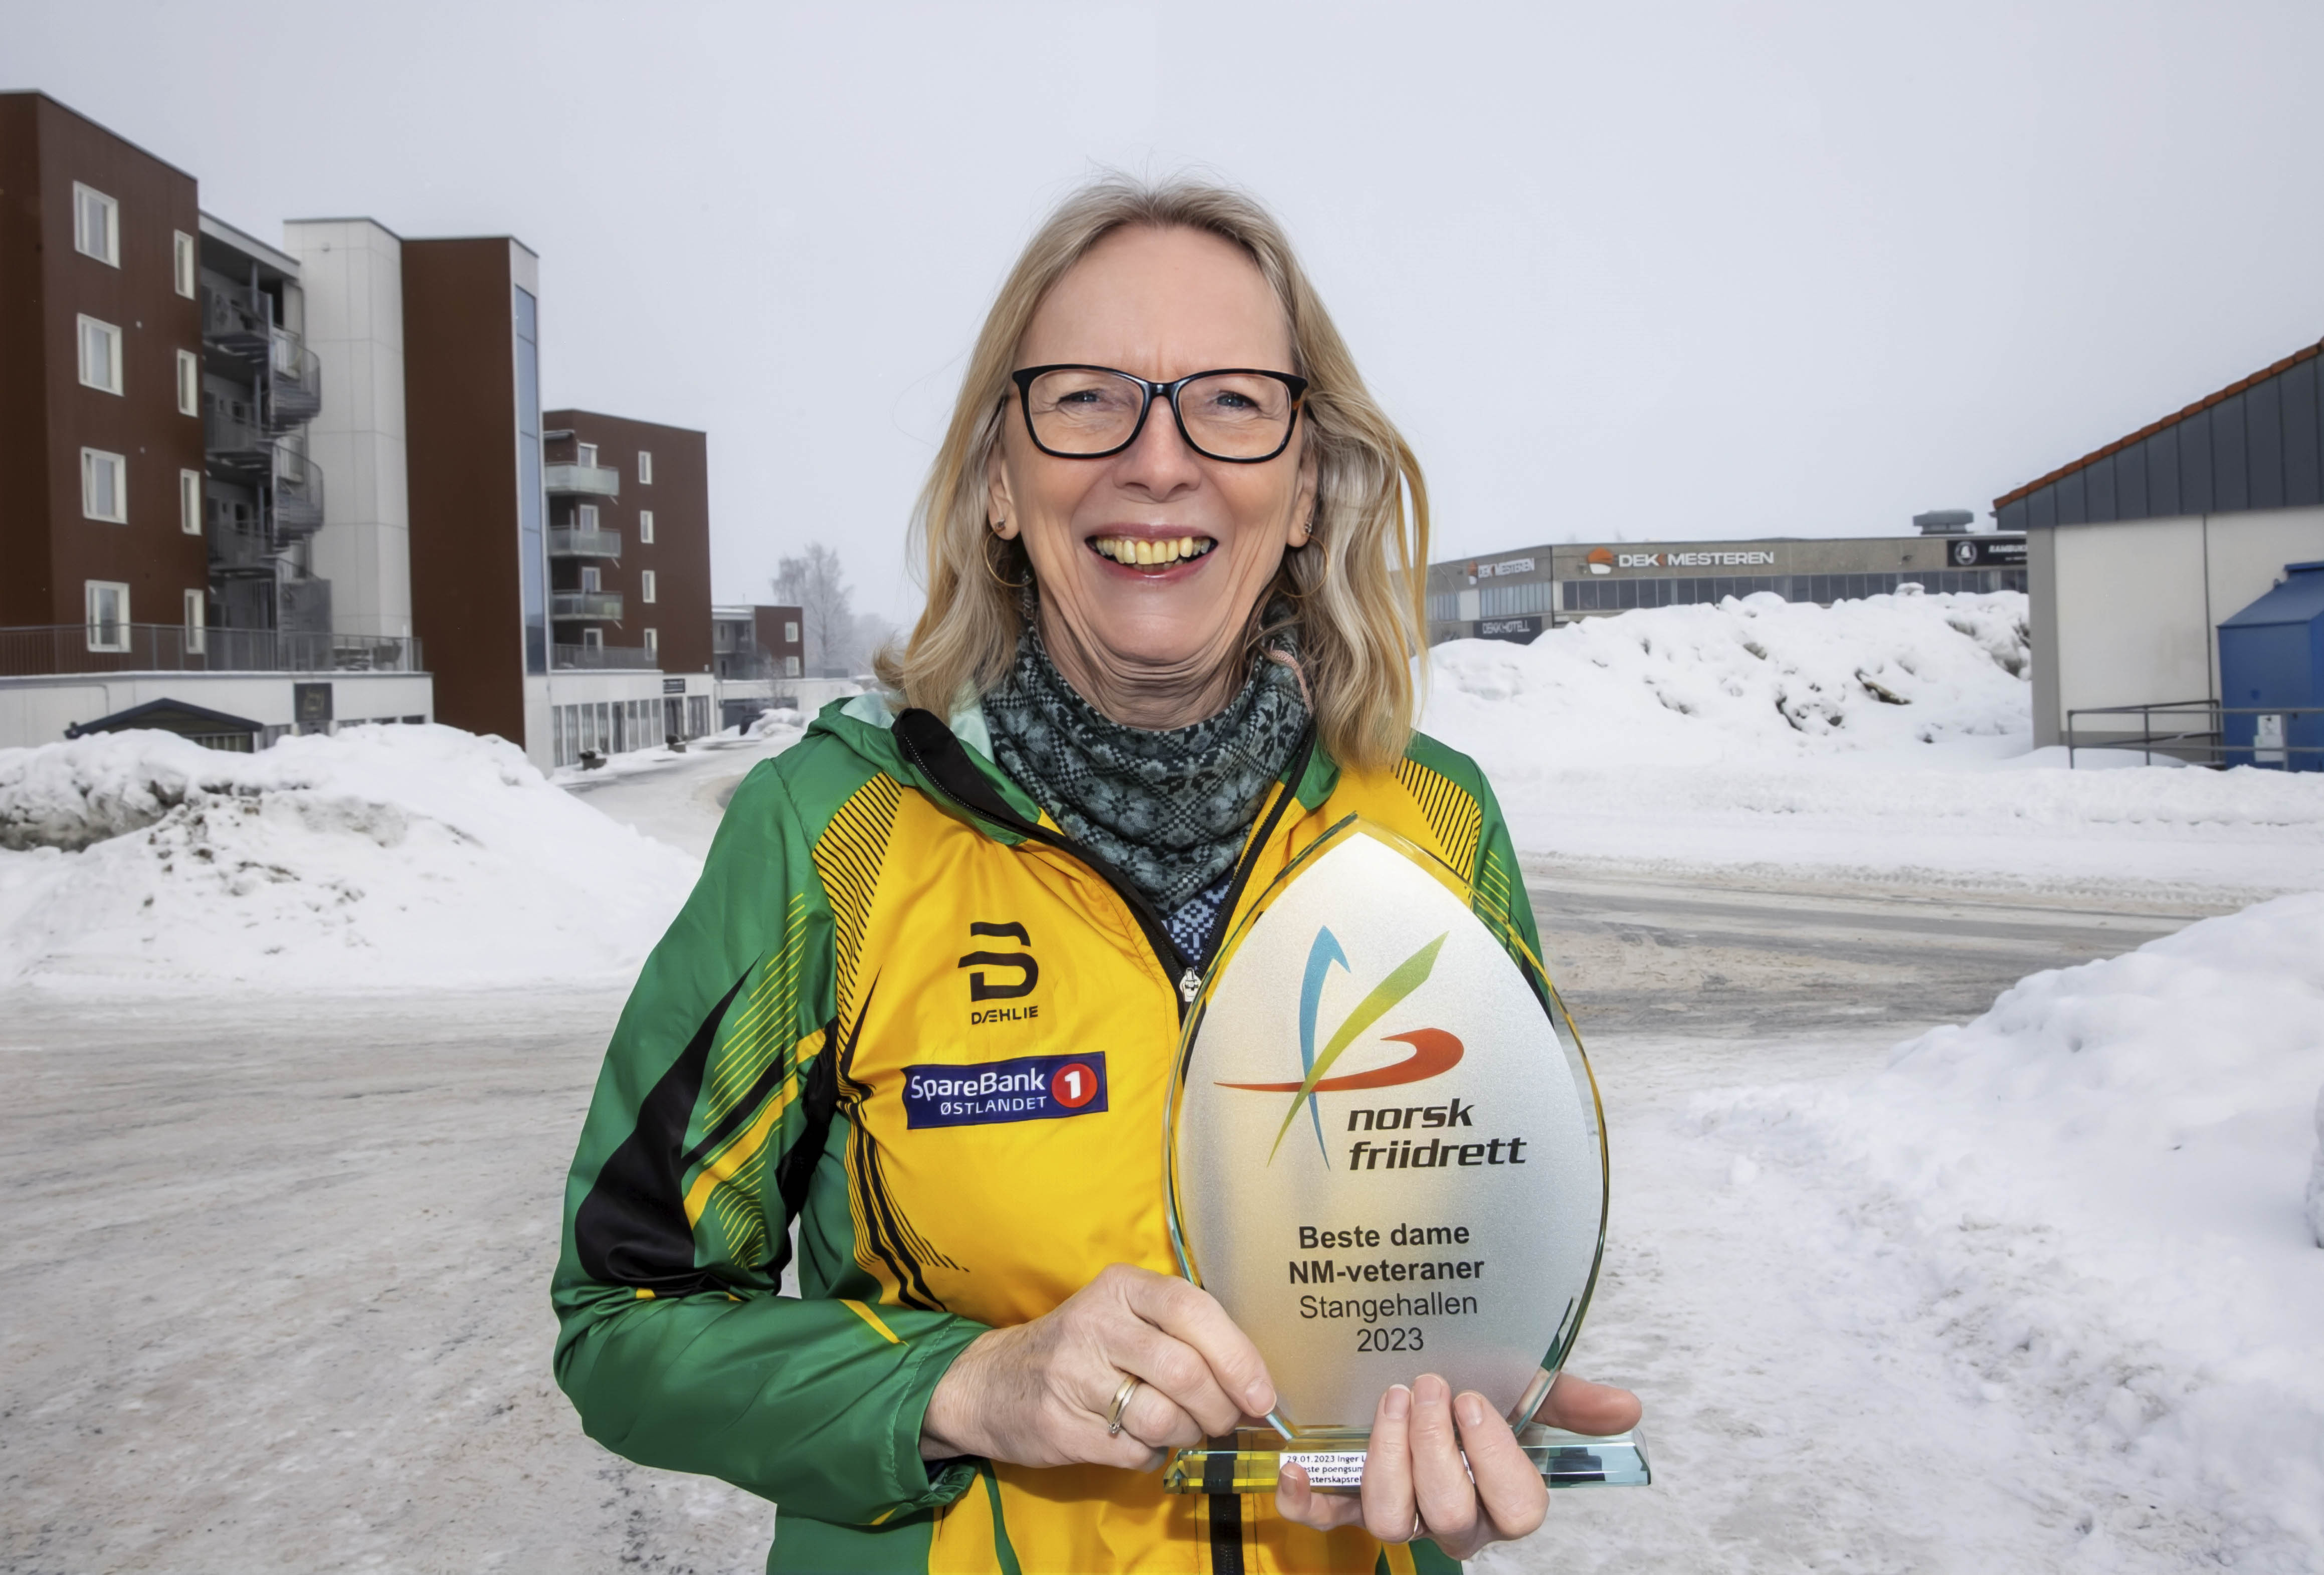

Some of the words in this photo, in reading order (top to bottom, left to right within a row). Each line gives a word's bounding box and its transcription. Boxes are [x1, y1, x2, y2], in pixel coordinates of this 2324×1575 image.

[971, 1005, 1039, 1025] DÆHLIE
[911, 1068, 1045, 1101] SpareBank
[1064, 1071, 1081, 1099] 1
[940, 1096, 1047, 1115] ØSTLANDET
[1347, 1098, 1475, 1131] norsk
[1349, 1137, 1527, 1170] friidrett
[1299, 1225, 1380, 1249] Beste
[1390, 1223, 1469, 1246] dame
[1289, 1259, 1485, 1284] NM-veteraner
[1300, 1292, 1477, 1323] Stangehallen
[1357, 1327, 1424, 1352] 2023
[1287, 1455, 1335, 1463] 29.01.2023
[1337, 1455, 1359, 1464] Inger
